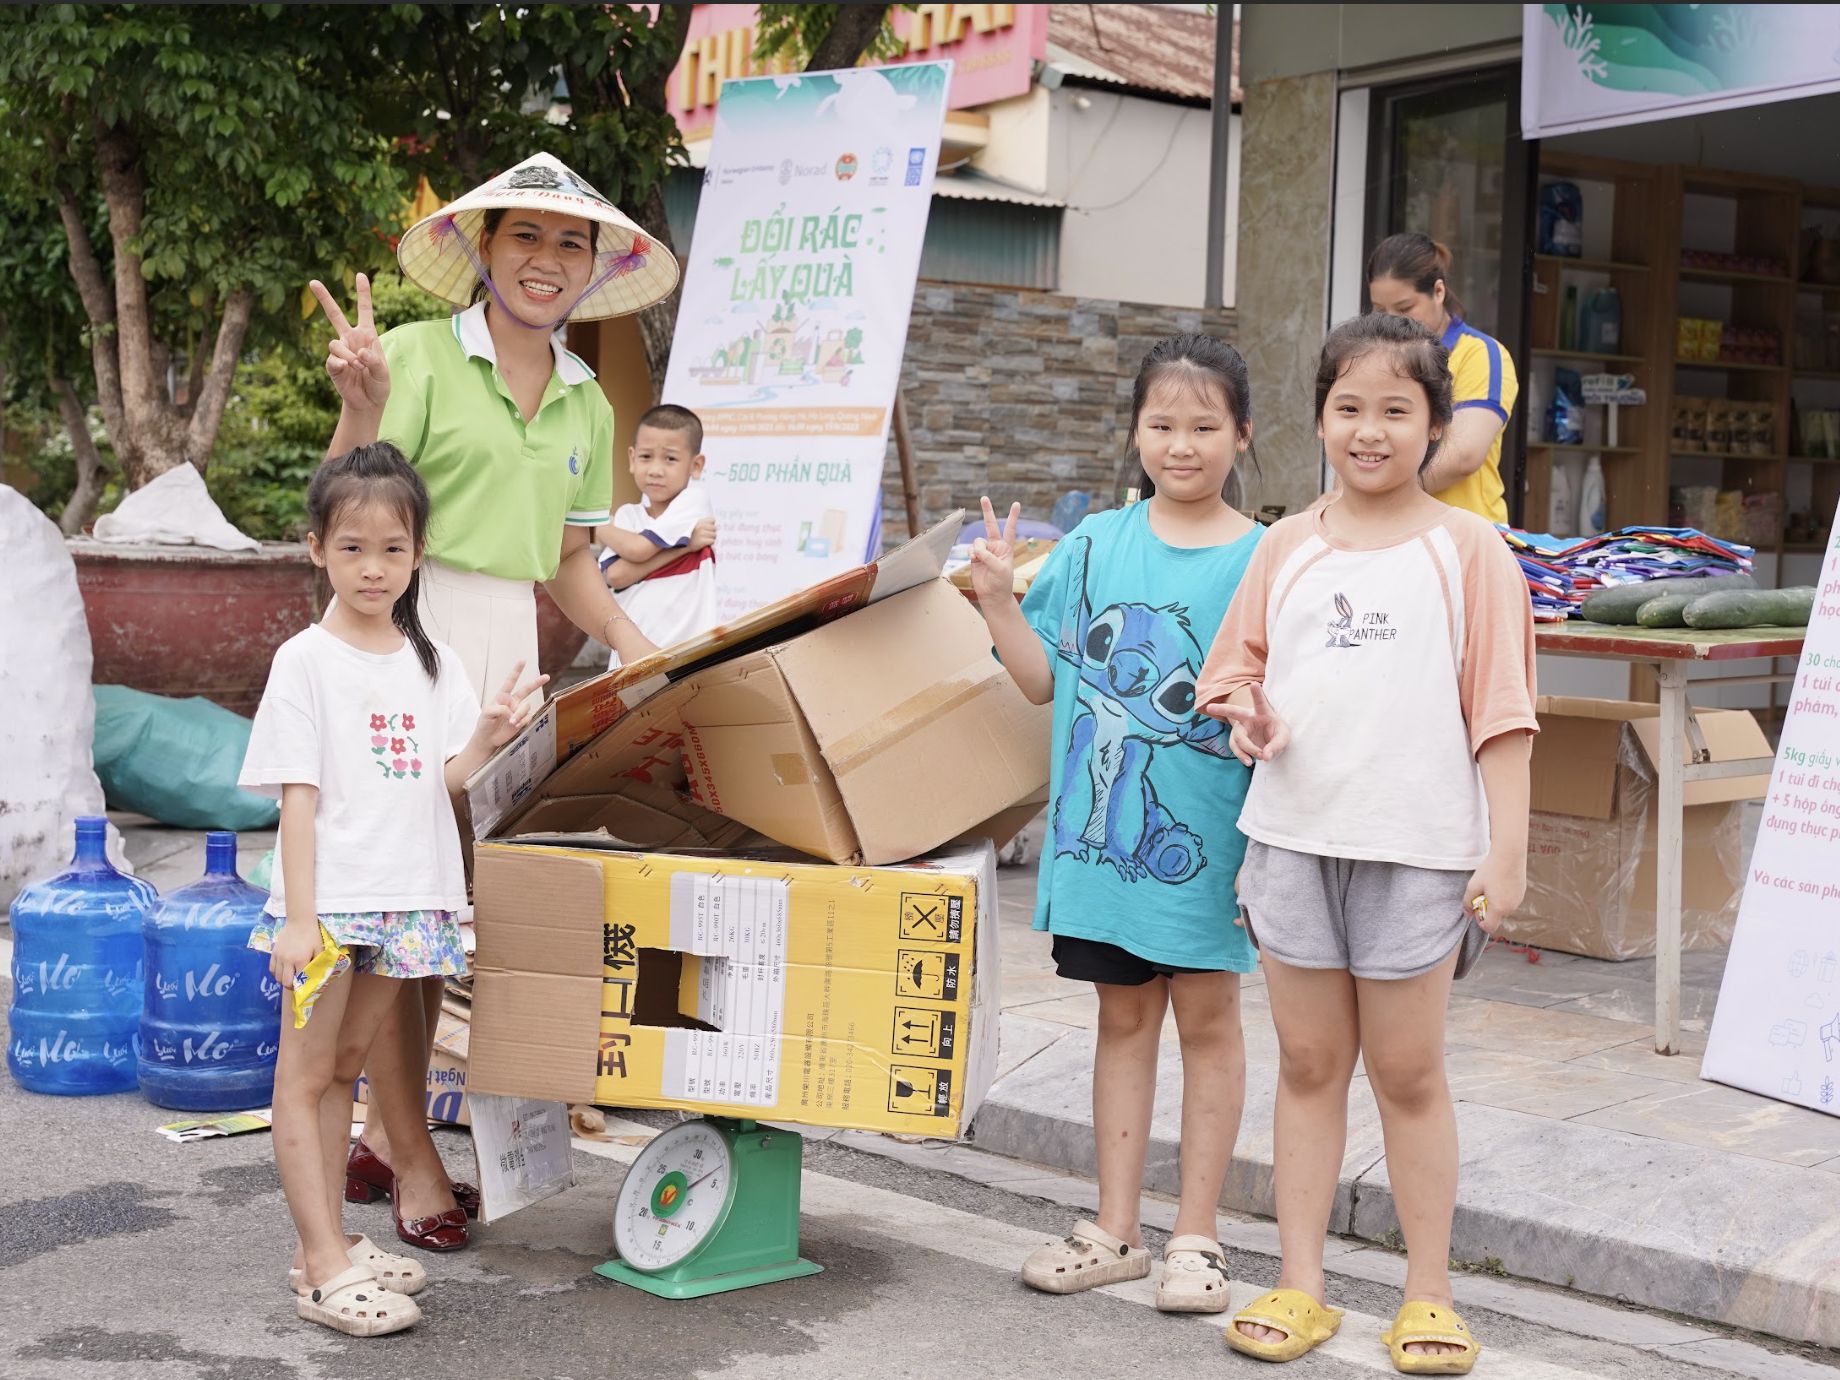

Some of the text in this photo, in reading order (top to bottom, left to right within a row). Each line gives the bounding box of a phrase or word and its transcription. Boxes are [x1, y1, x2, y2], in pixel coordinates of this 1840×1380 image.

[794, 162, 828, 177] Norad
[740, 202, 863, 254] ĐỔI RÁC
[730, 253, 853, 305] LẤY QUÀ
[816, 458, 852, 486] QUÀ
[1362, 612, 1389, 625] PINK
[1349, 628, 1397, 640] PANTHER
[1805, 653, 1821, 666] 30
[1802, 674, 1832, 691] 1 túi
[1783, 746, 1806, 766] 5kg
[1808, 748, 1831, 769] giấy
[1778, 770, 1785, 784] 1
[1788, 773, 1806, 787] túi
[1808, 774, 1820, 788] đi
[1783, 794, 1791, 806] 5
[1793, 795, 1817, 815] hộp
[1766, 815, 1797, 835] đựng
[1800, 820, 1828, 838] thực
[1754, 869, 1769, 885] Và
[1773, 875, 1795, 890] các
[1798, 880, 1819, 895] sản
[946, 965, 957, 989] 防水
[942, 1024, 953, 1047] 向上
[435, 1068, 466, 1086] Ngát
[938, 1081, 949, 1104] 輕放
[693, 1149, 703, 1159] 30
[657, 1164, 666, 1175] 25
[711, 1179, 717, 1188] 5
[638, 1207, 648, 1218] 20
[685, 1220, 695, 1231] 10
[652, 1240, 662, 1251] 15
